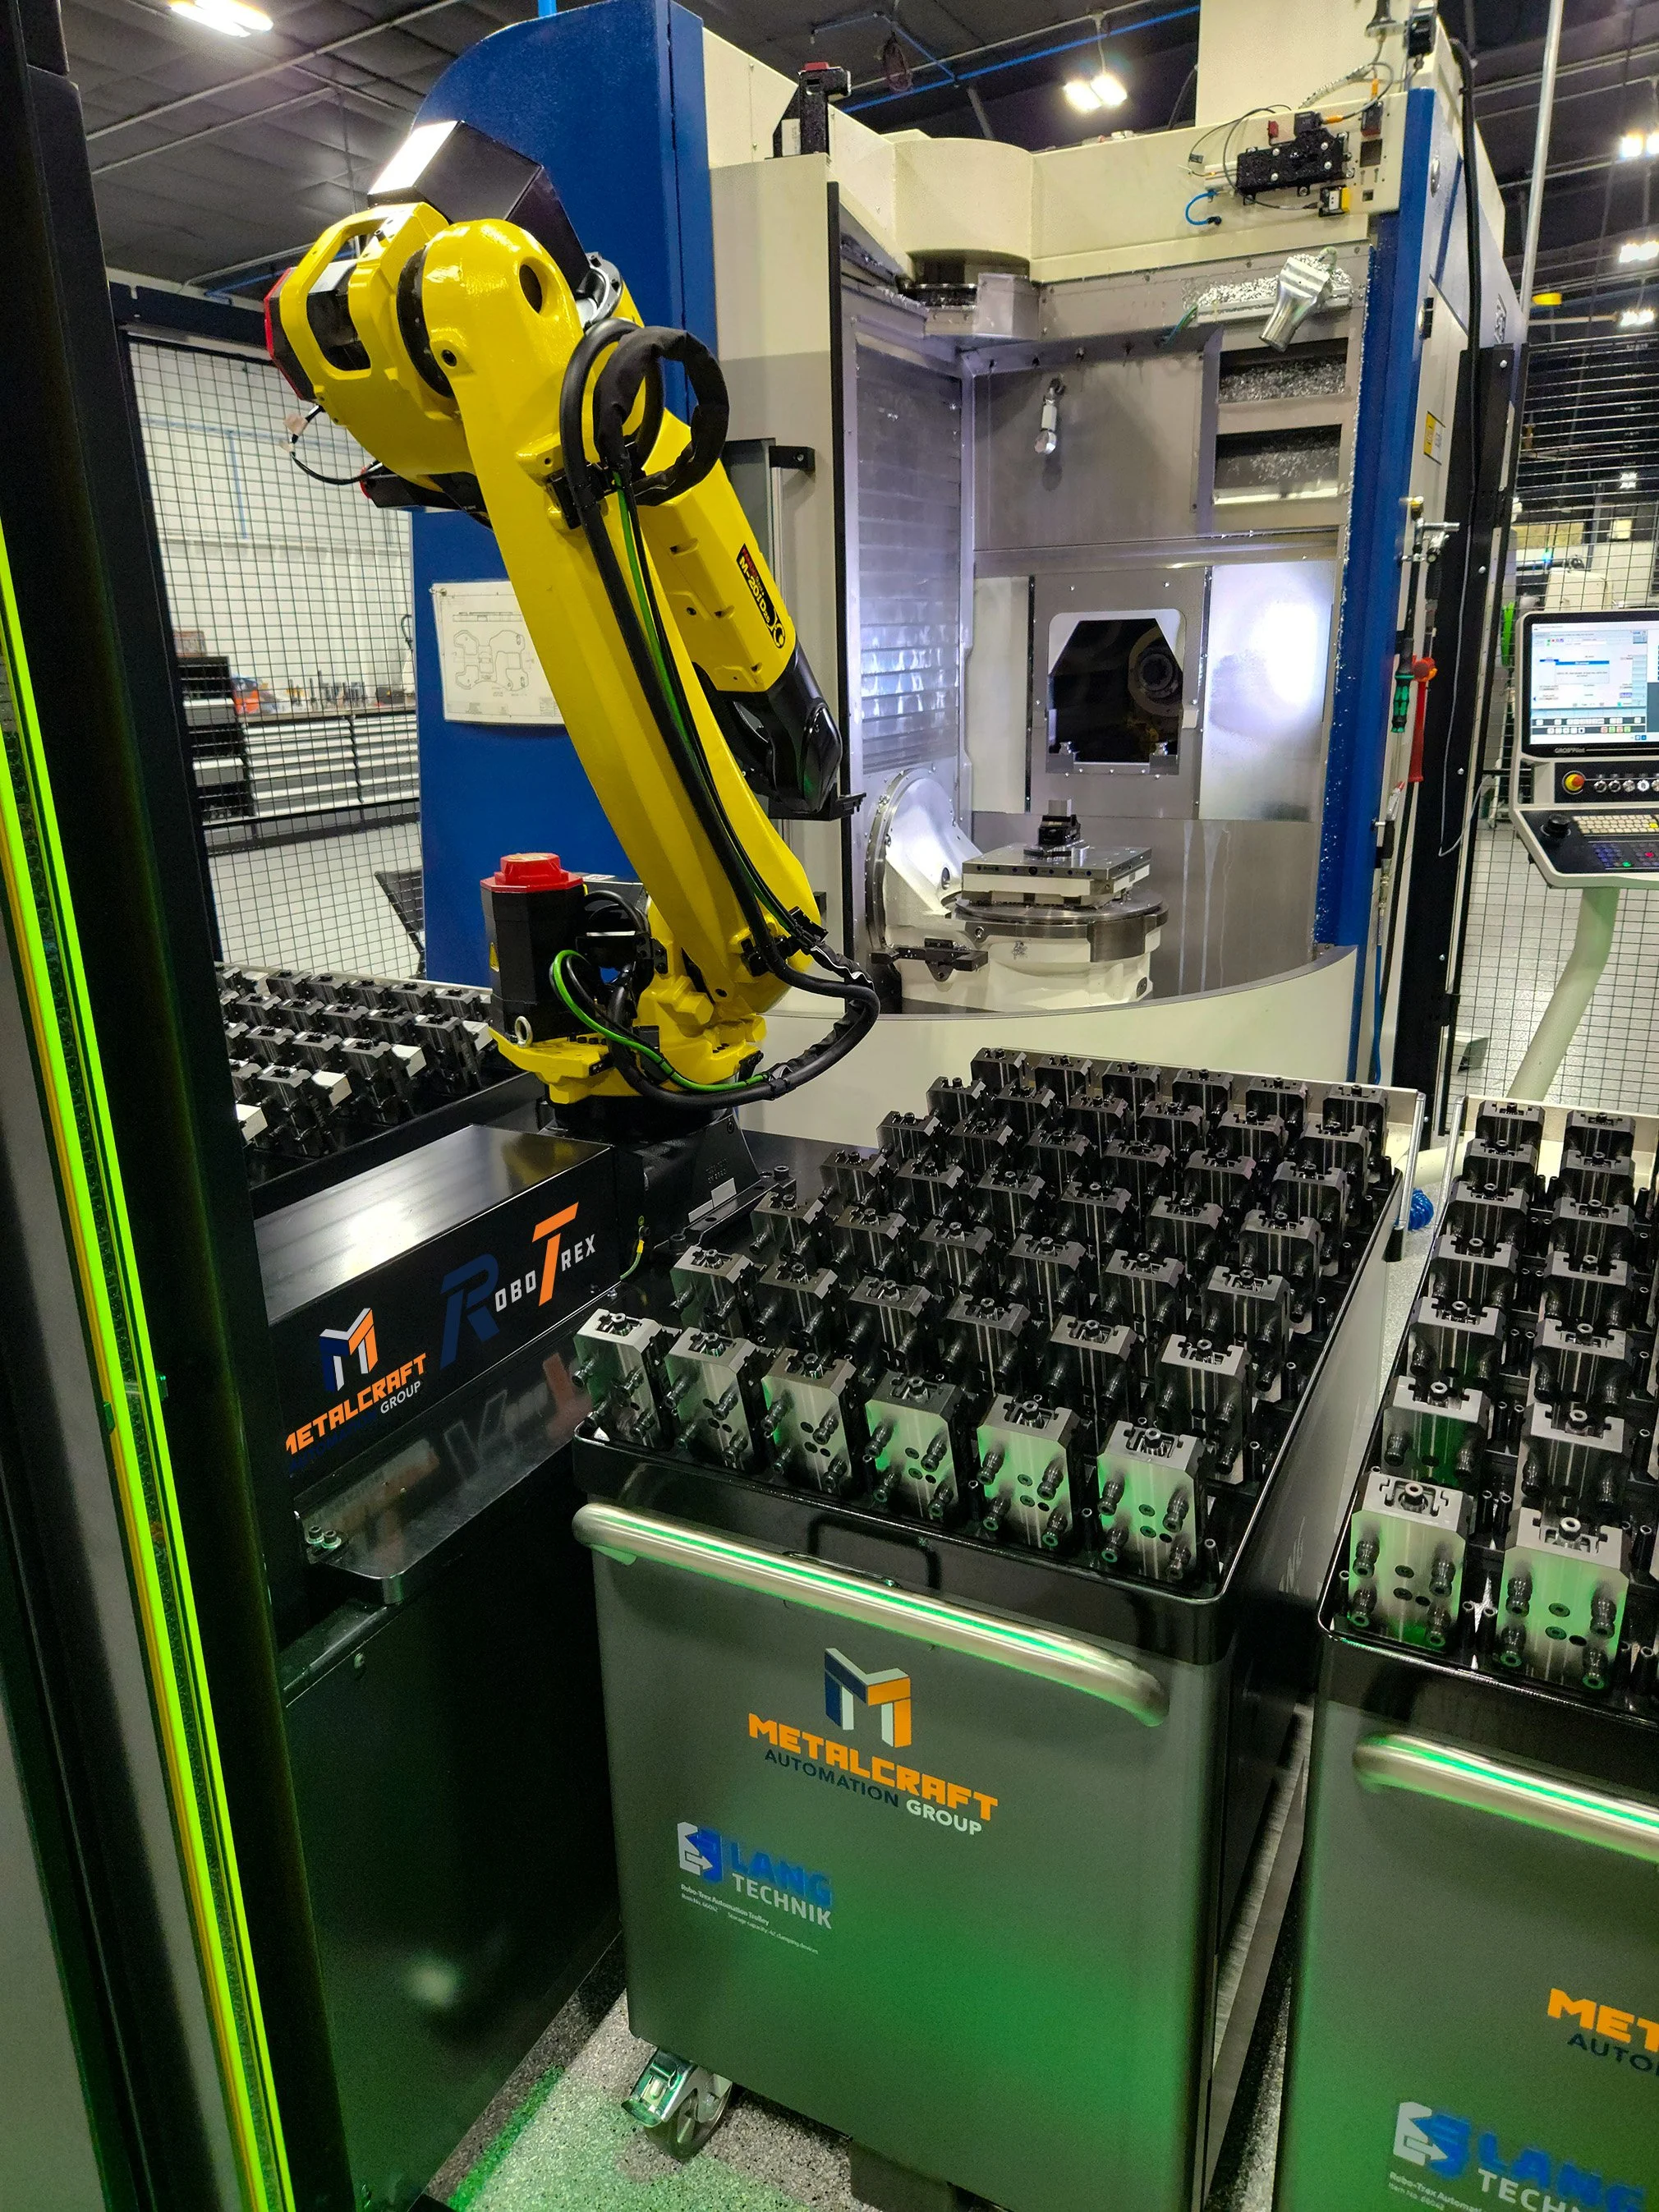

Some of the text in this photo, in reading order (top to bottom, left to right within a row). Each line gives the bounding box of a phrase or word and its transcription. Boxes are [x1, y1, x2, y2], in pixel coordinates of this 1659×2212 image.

[380, 1381, 421, 1415] GROUP
[747, 1712, 999, 1822] METALCRAFT
[764, 1749, 982, 1835] AUTOMATION GROUP
[729, 1840, 833, 1908] LANG
[732, 1873, 832, 1929] TECHNIK
[711, 1896, 748, 1916] Automation
[1389, 2171, 1437, 2198] Robo-Trex
